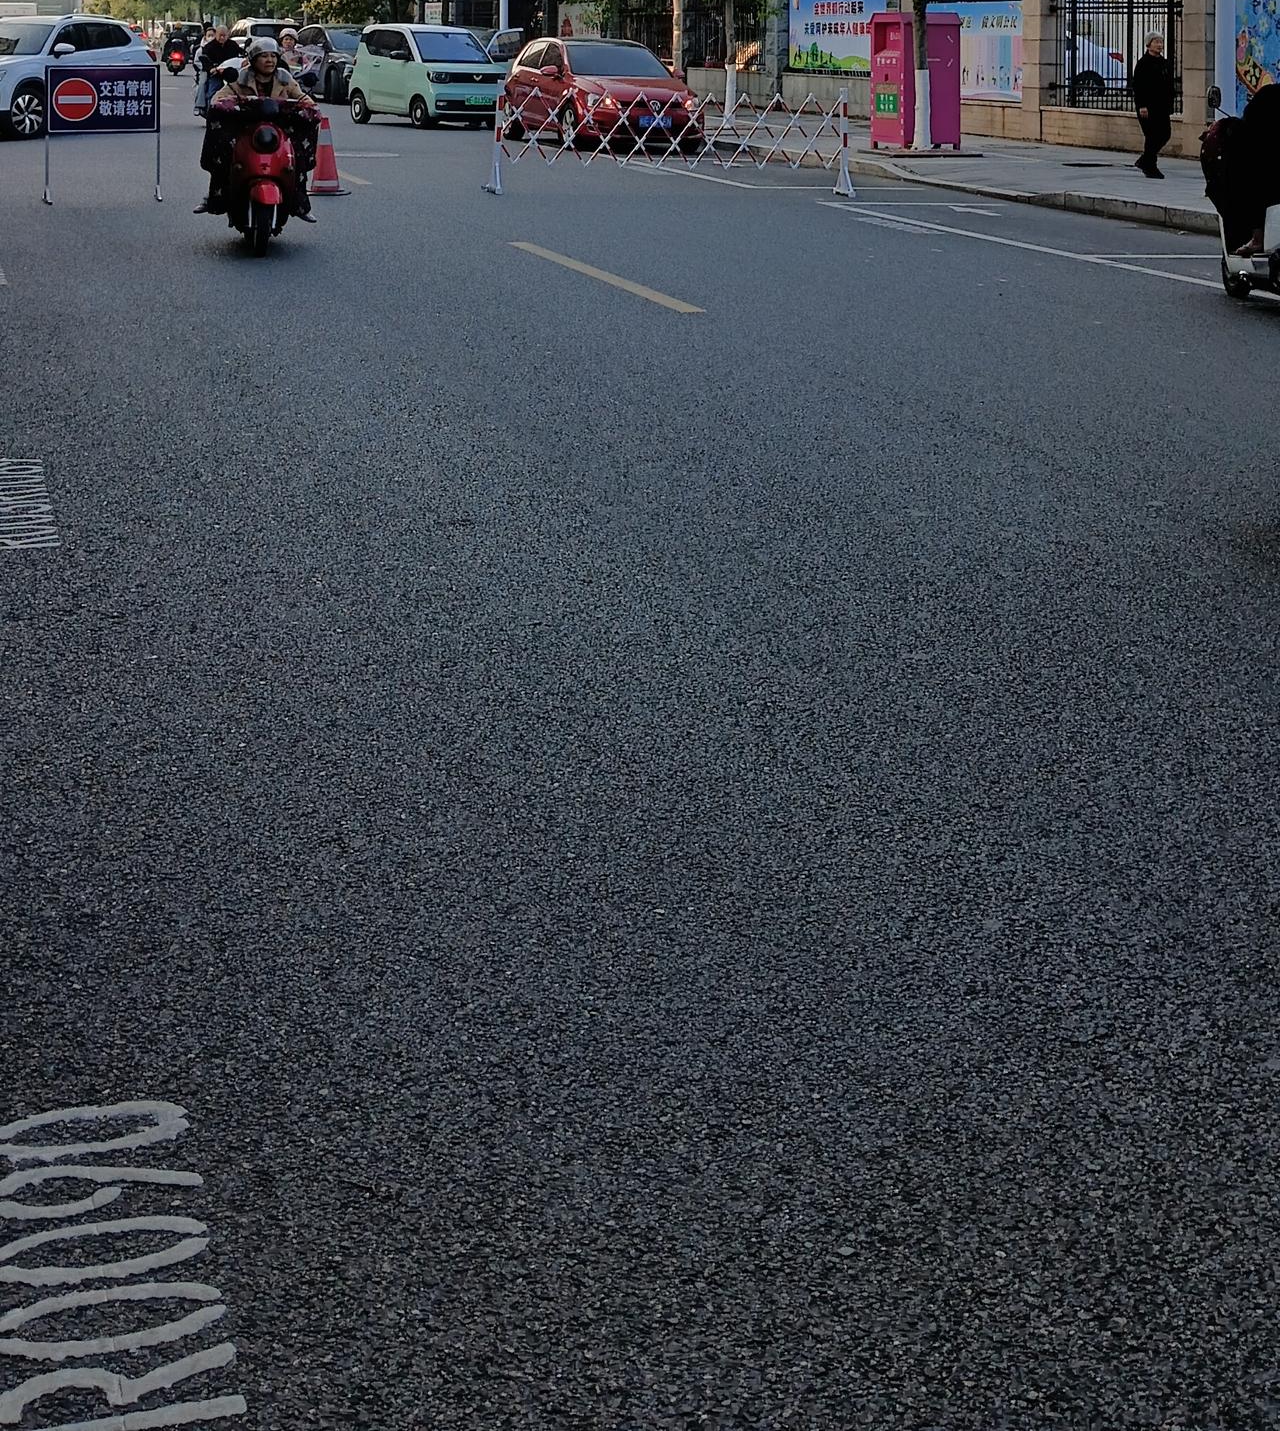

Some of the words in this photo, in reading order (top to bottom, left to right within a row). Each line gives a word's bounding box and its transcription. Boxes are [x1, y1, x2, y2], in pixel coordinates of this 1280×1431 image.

[814, 1, 864, 15] 全世界都行动起来
[99, 80, 152, 97] 交通管制
[99, 100, 152, 116] 敬请绕行
